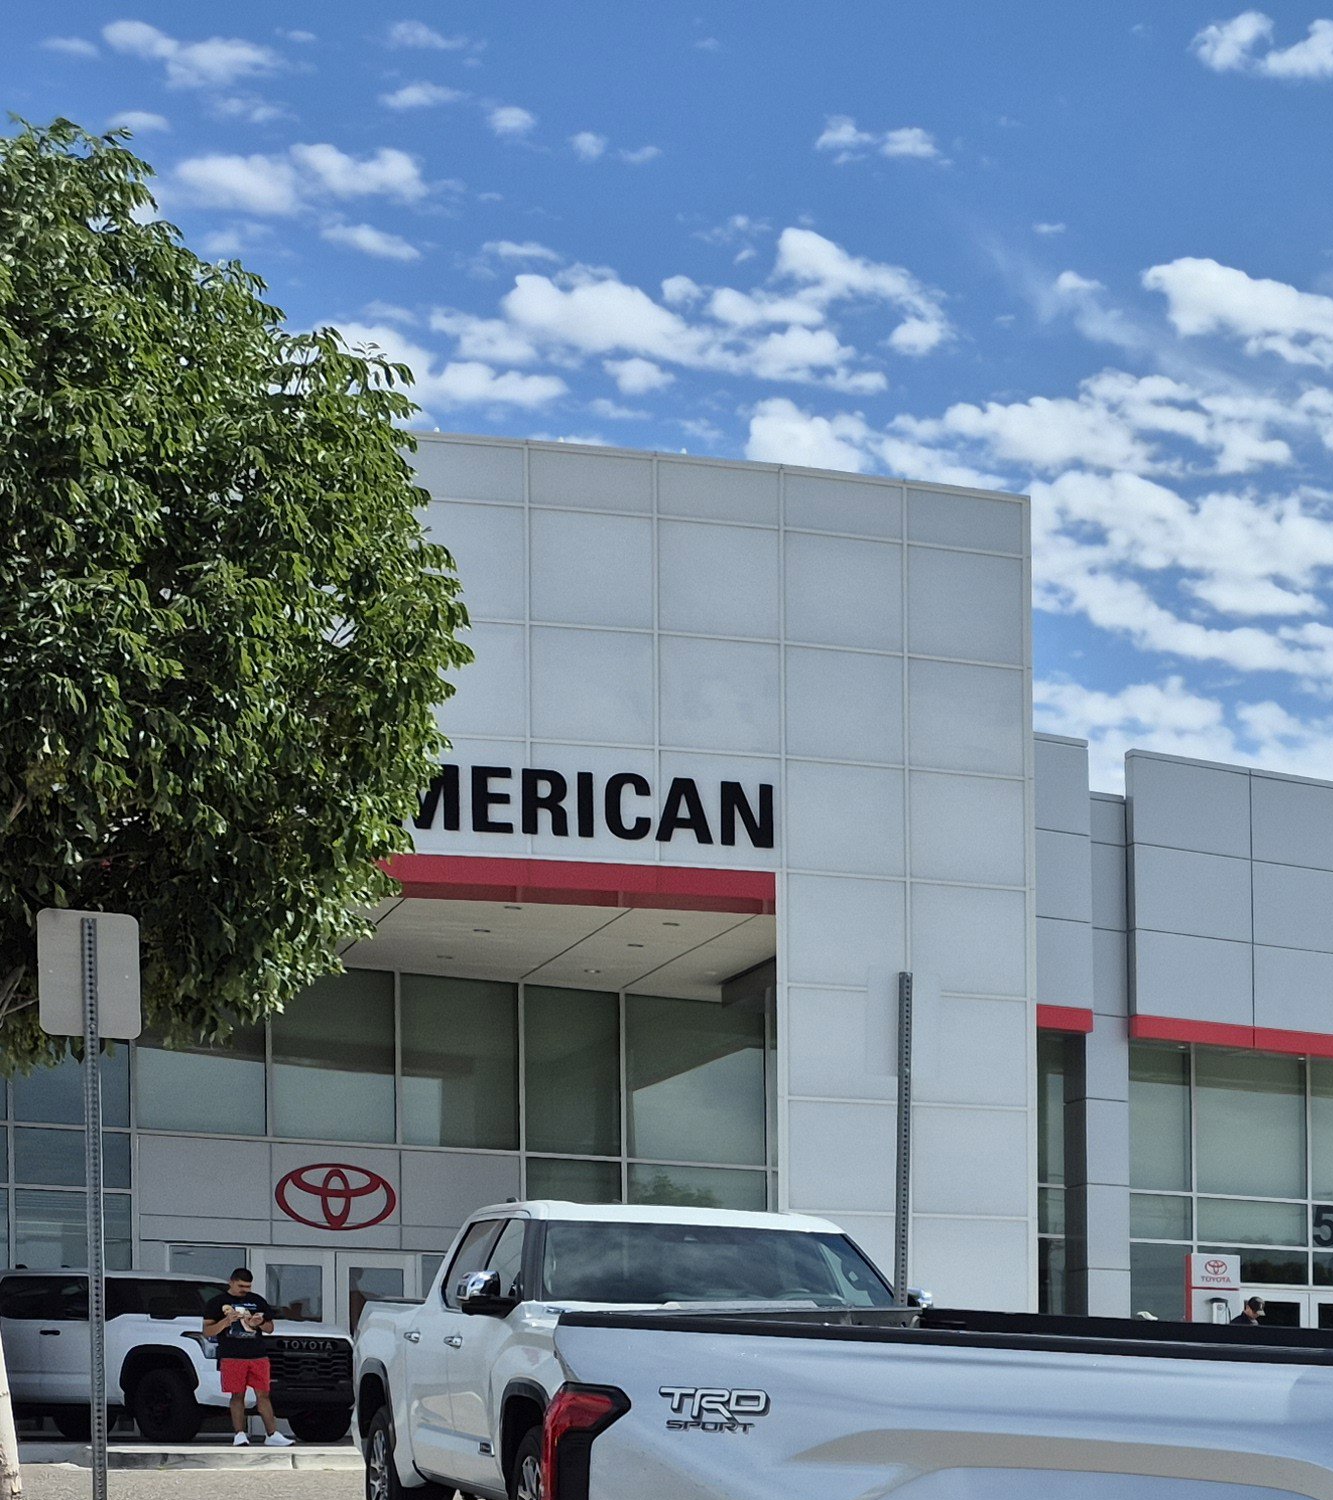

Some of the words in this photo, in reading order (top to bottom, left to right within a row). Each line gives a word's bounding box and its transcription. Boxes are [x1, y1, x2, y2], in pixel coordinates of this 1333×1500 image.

[389, 764, 774, 849] MERICAN
[1201, 1275, 1231, 1283] TOYOTA
[283, 1340, 333, 1350] TOYOTA
[659, 1386, 770, 1420] TRD
[666, 1420, 756, 1433] SPORT
